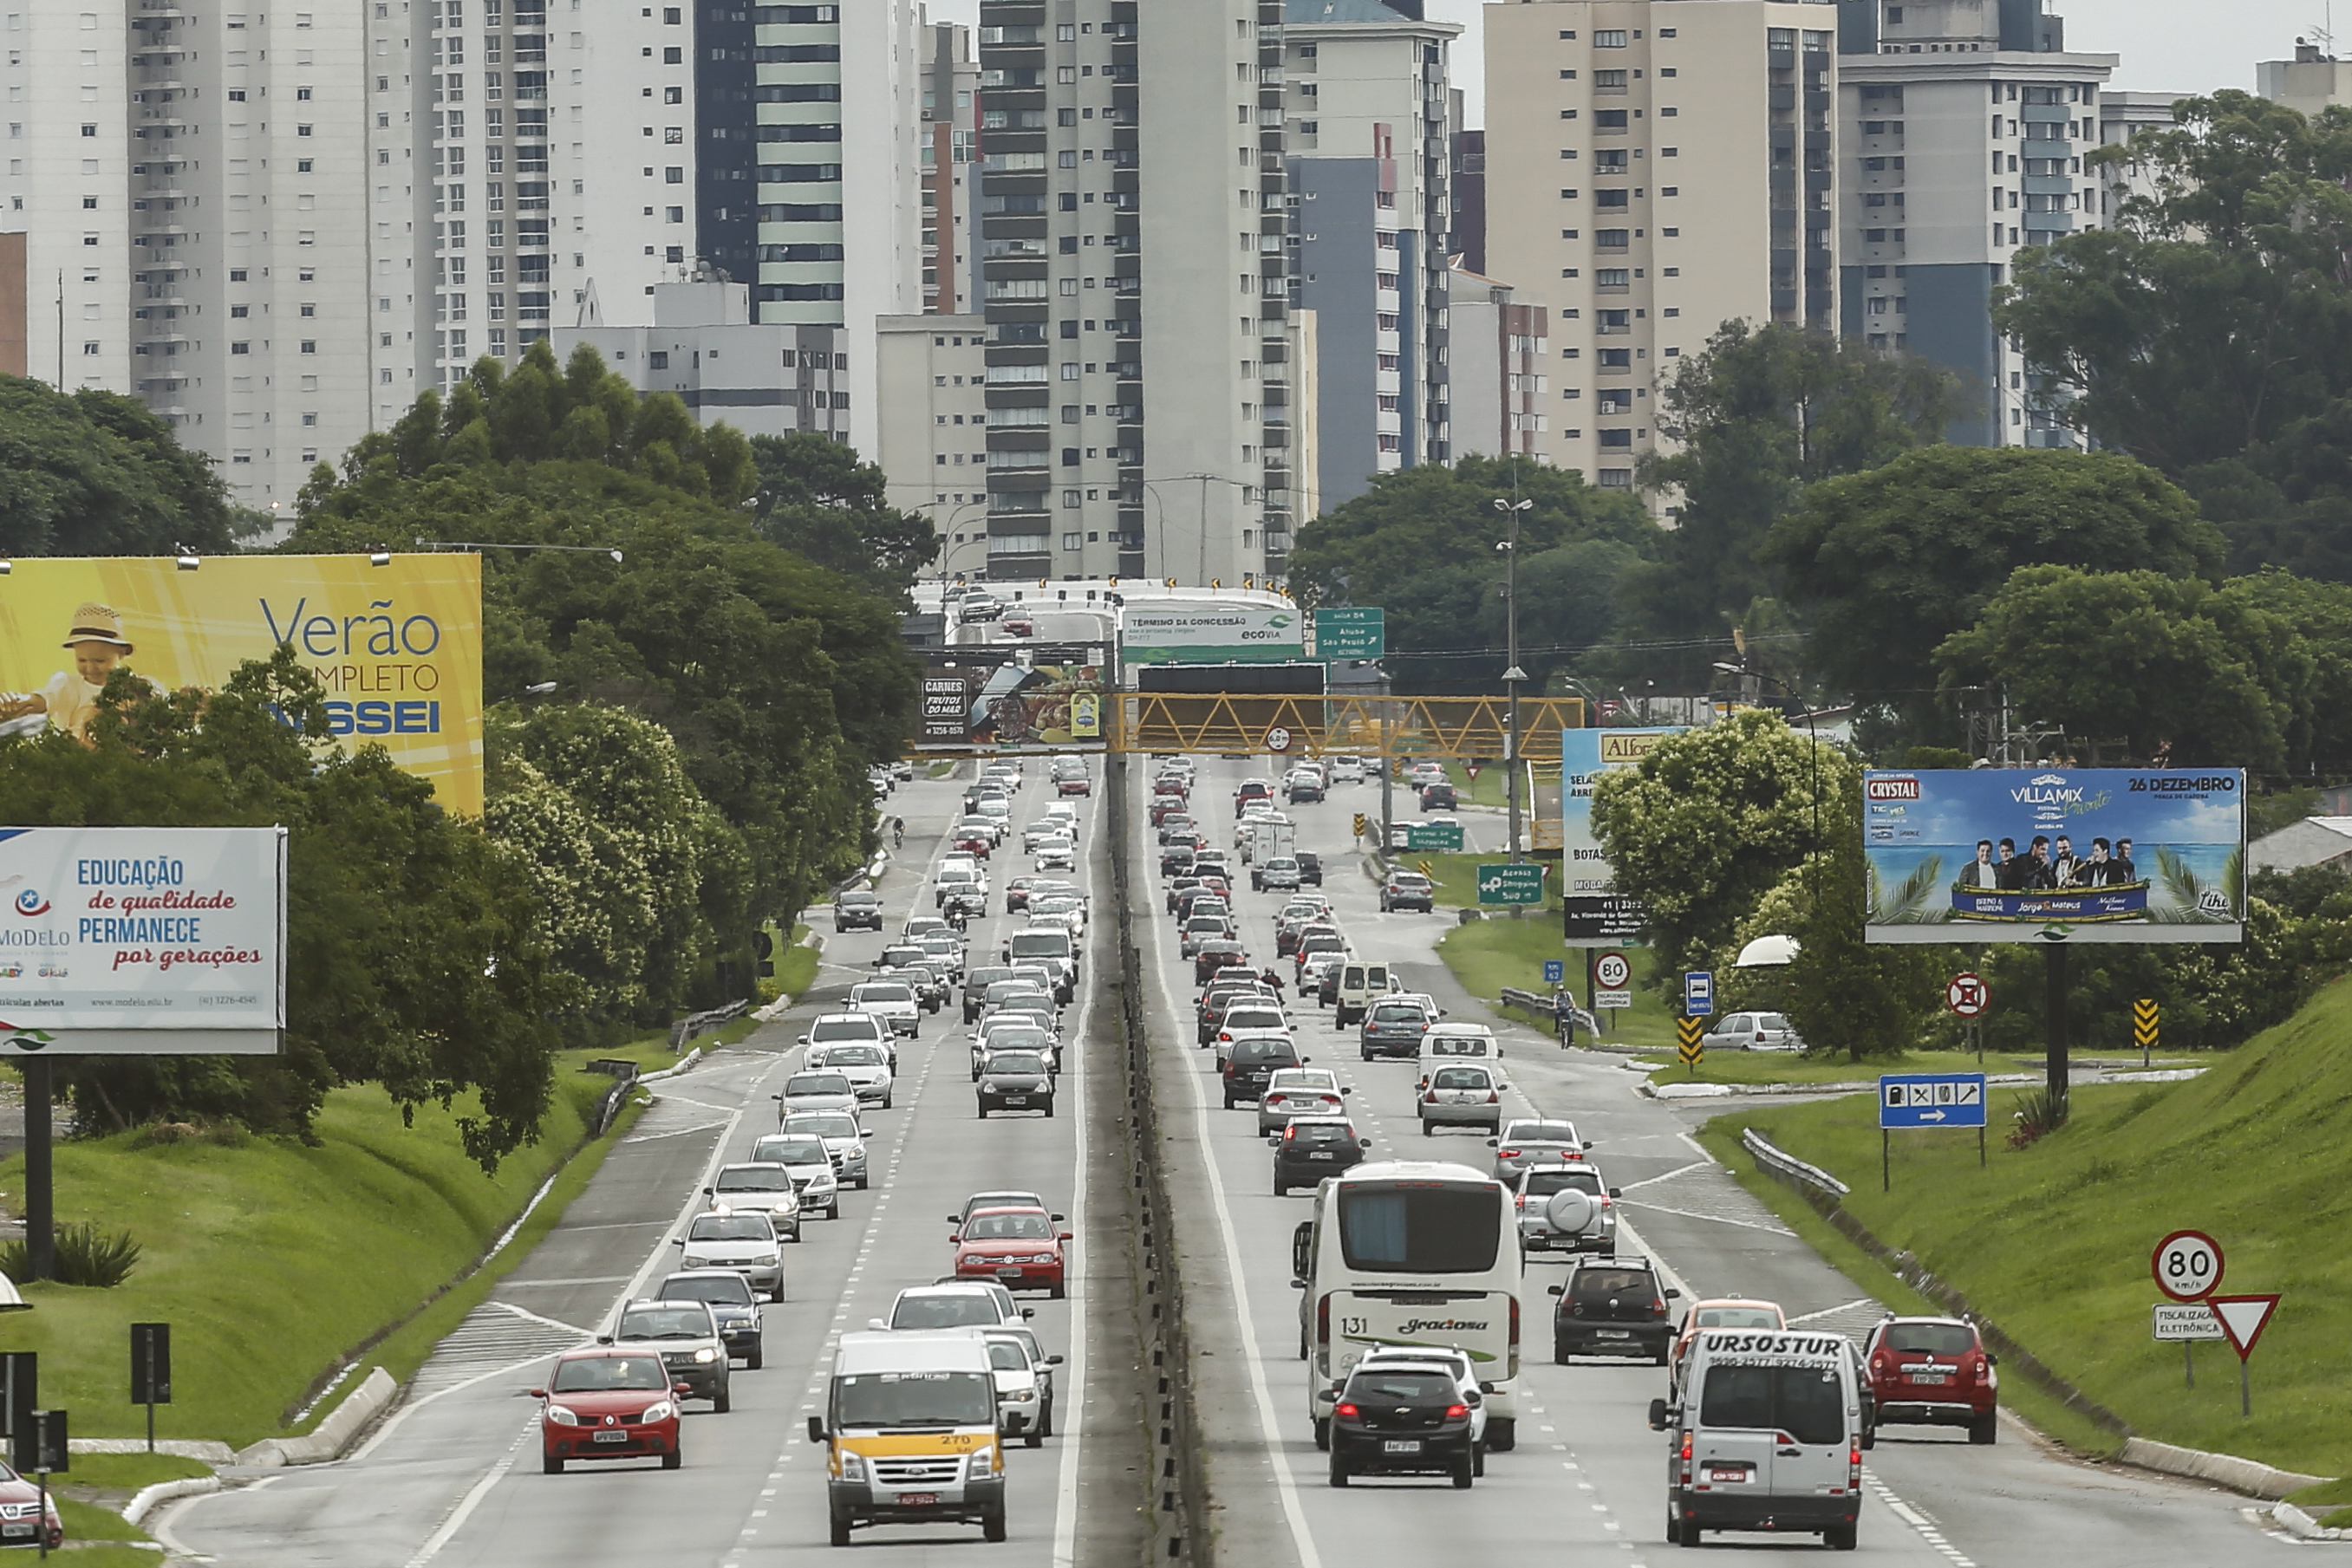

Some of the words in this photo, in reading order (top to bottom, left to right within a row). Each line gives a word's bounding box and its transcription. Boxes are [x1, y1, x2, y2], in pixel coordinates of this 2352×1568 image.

[259, 597, 440, 657] Verão
[1131, 617, 1173, 627] TÉRMINO
[1190, 617, 1246, 626] CONCESSÃO
[925, 681, 963, 693] CARNES
[926, 696, 962, 706] FRUTOS
[928, 705, 941, 714] DO
[941, 705, 961, 714] MAR
[1606, 738, 1654, 757] Alfor
[1869, 781, 1917, 797] CRYSTAL
[2128, 777, 2147, 791] 26
[2149, 777, 2236, 791] DEZEMBRO
[78, 855, 184, 890] EDUCAÇÃO
[1502, 879, 1539, 889] Shopping
[88, 889, 116, 910] de
[121, 889, 237, 917] qualidade
[2017, 902, 2043, 914] Jorge
[2051, 900, 2082, 910] Mateus
[78, 917, 201, 943] PERMANECE
[112, 947, 156, 971] por
[160, 945, 264, 971] gerações
[1602, 962, 1624, 977] 80
[2167, 1250, 2211, 1278] 80
[2174, 1280, 2202, 1290] km/h
[1340, 1318, 1369, 1335] 131
[1706, 1334, 1841, 1358] URSOSTUR
